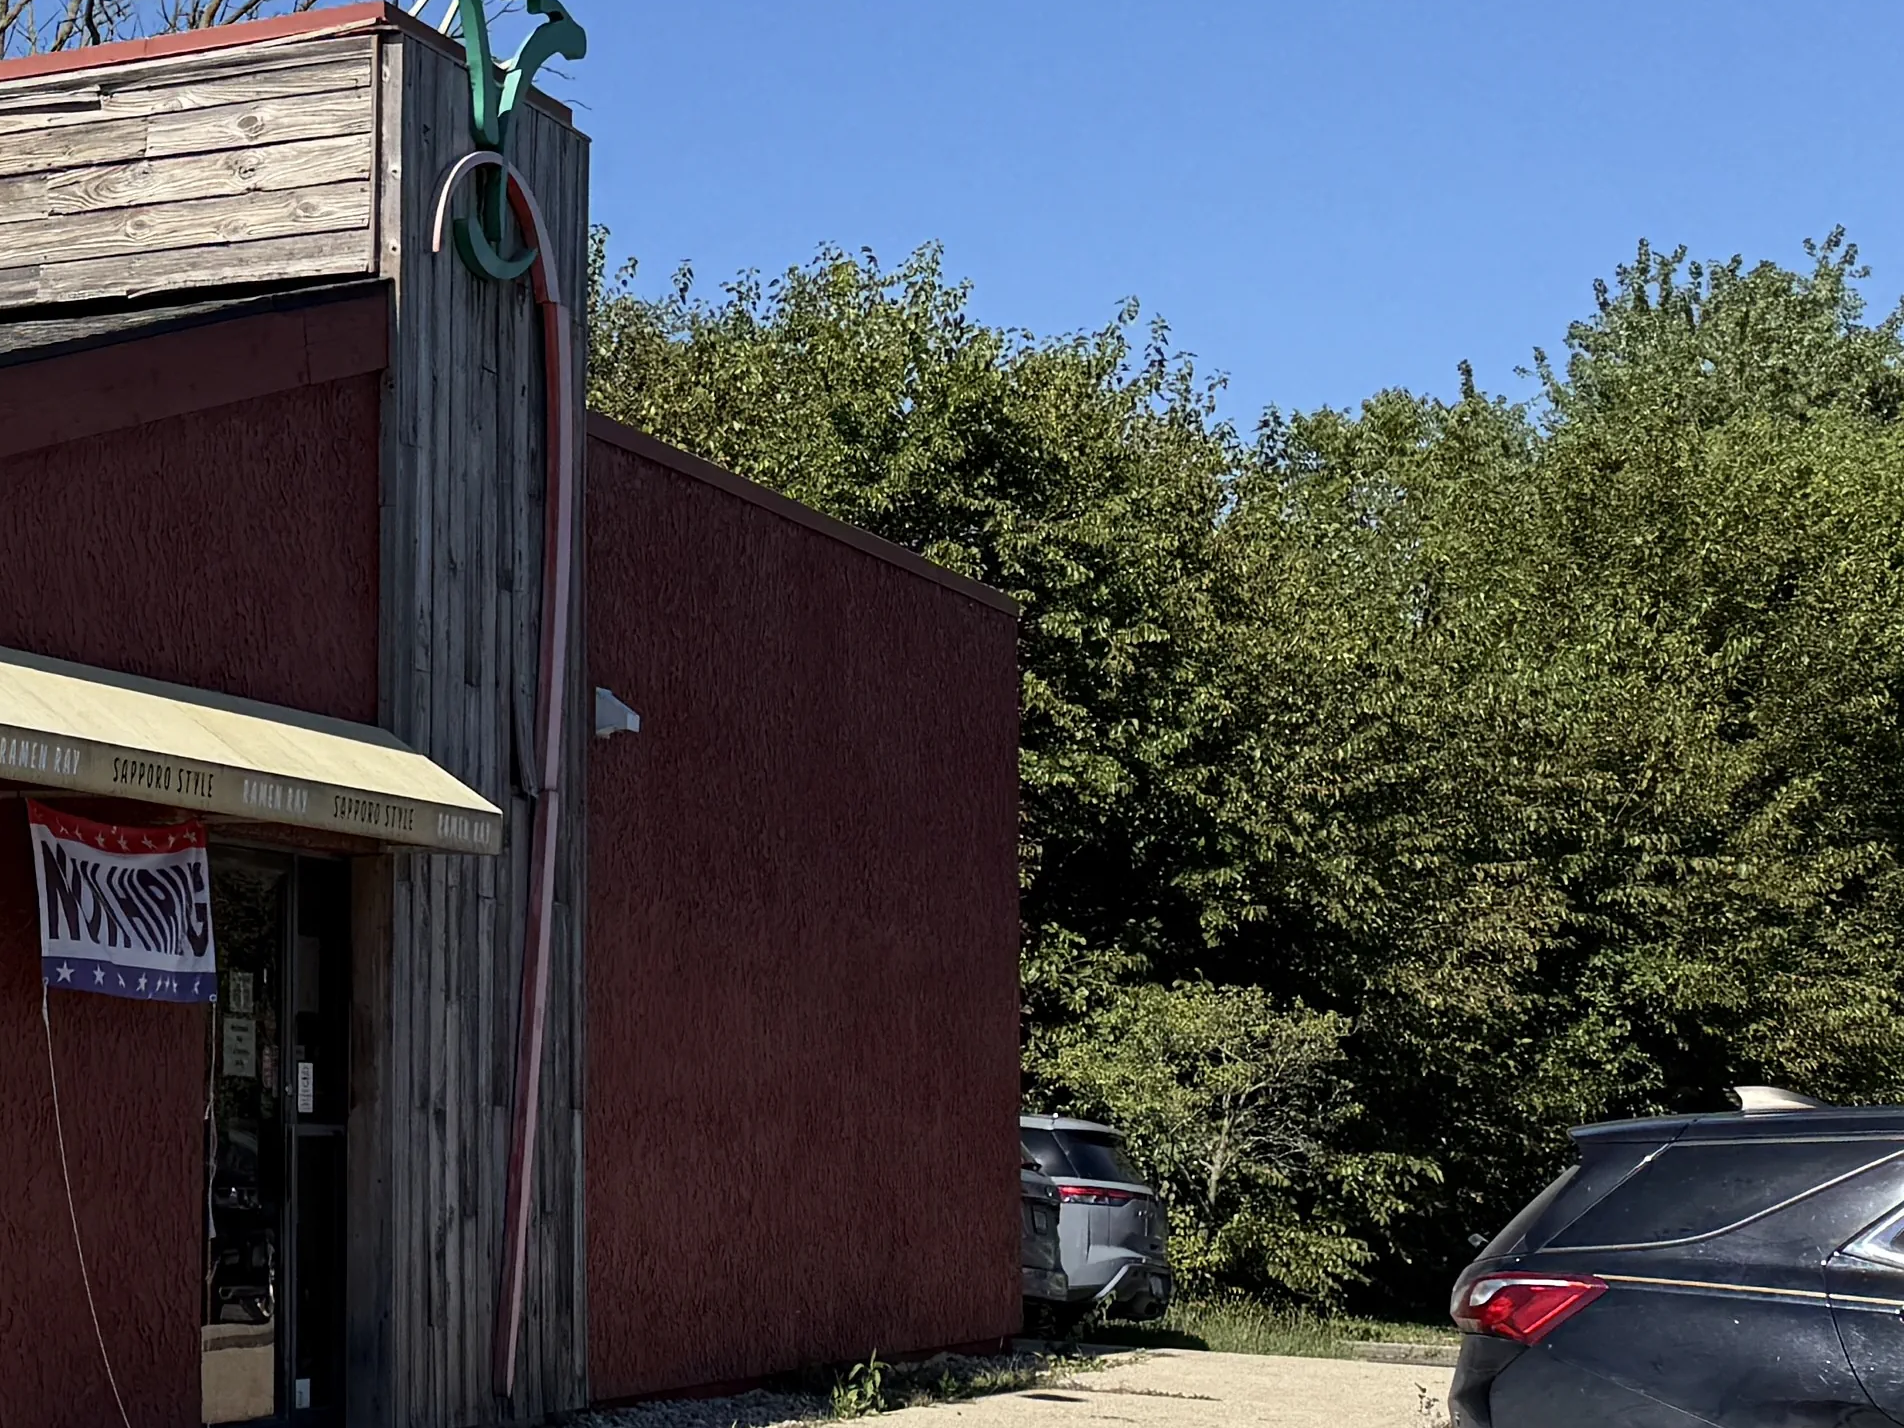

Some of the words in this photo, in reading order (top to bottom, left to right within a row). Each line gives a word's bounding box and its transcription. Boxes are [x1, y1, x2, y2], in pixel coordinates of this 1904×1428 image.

[53, 746, 81, 775] RAY
[112, 757, 171, 791] SAPPORO
[176, 768, 213, 799] STYLE
[243, 779, 282, 811] RAMEN
[286, 787, 308, 813] RAY
[333, 795, 380, 825] SAPPORO
[385, 804, 415, 831] STYLE
